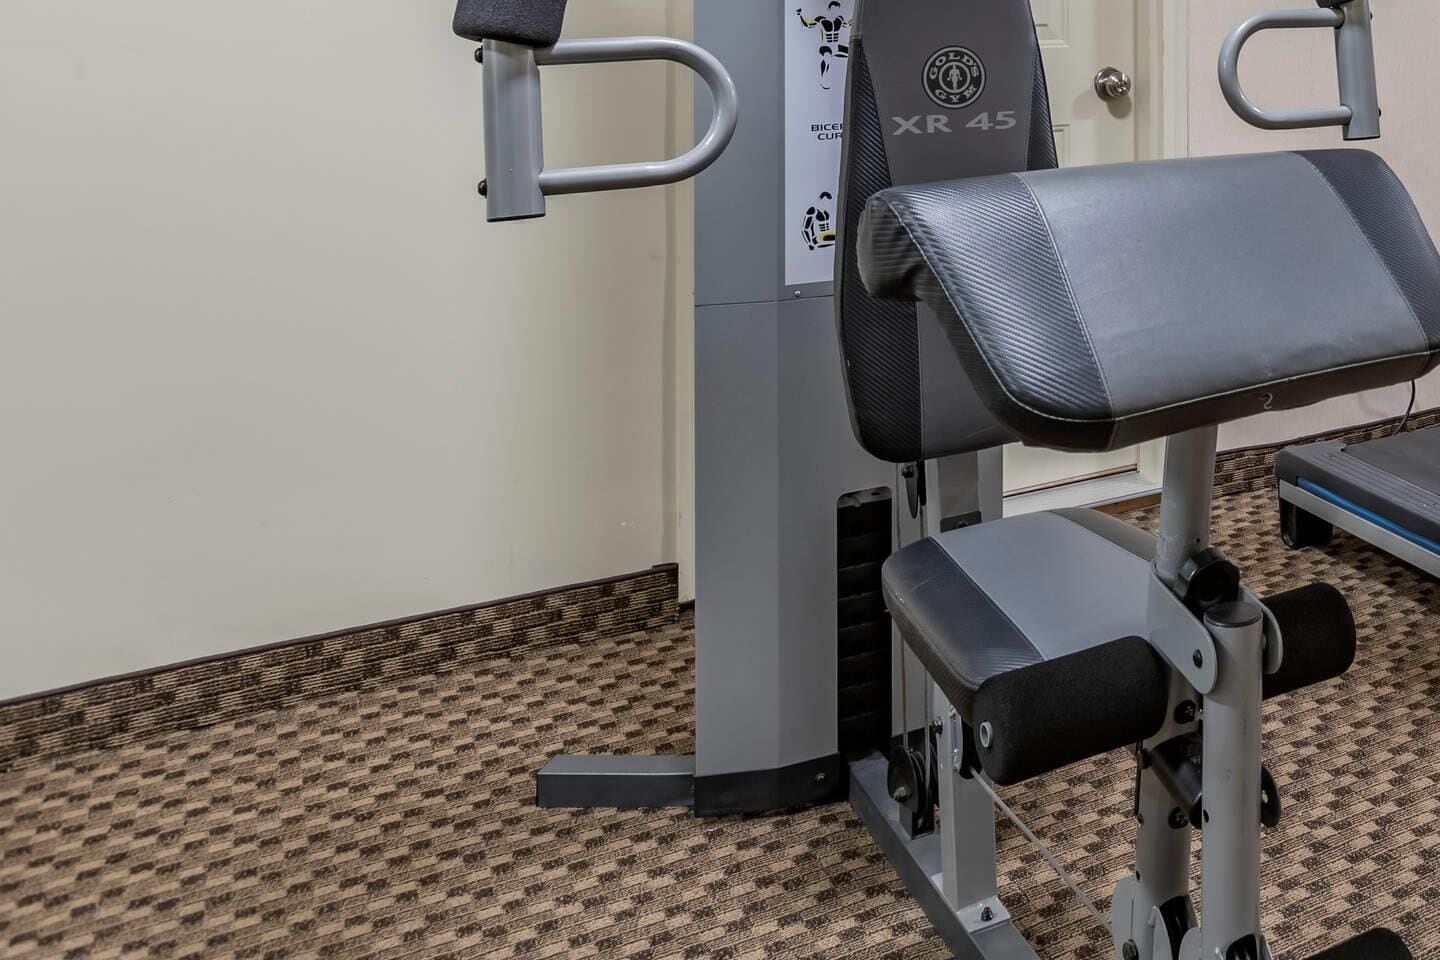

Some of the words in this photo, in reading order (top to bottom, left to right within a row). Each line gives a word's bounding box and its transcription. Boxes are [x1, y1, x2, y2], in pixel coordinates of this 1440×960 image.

[929, 52, 980, 80] GOLD'S
[935, 84, 978, 103] GYM
[891, 114, 953, 136] XR
[964, 110, 1017, 131] 45
[817, 132, 843, 141] CUR
